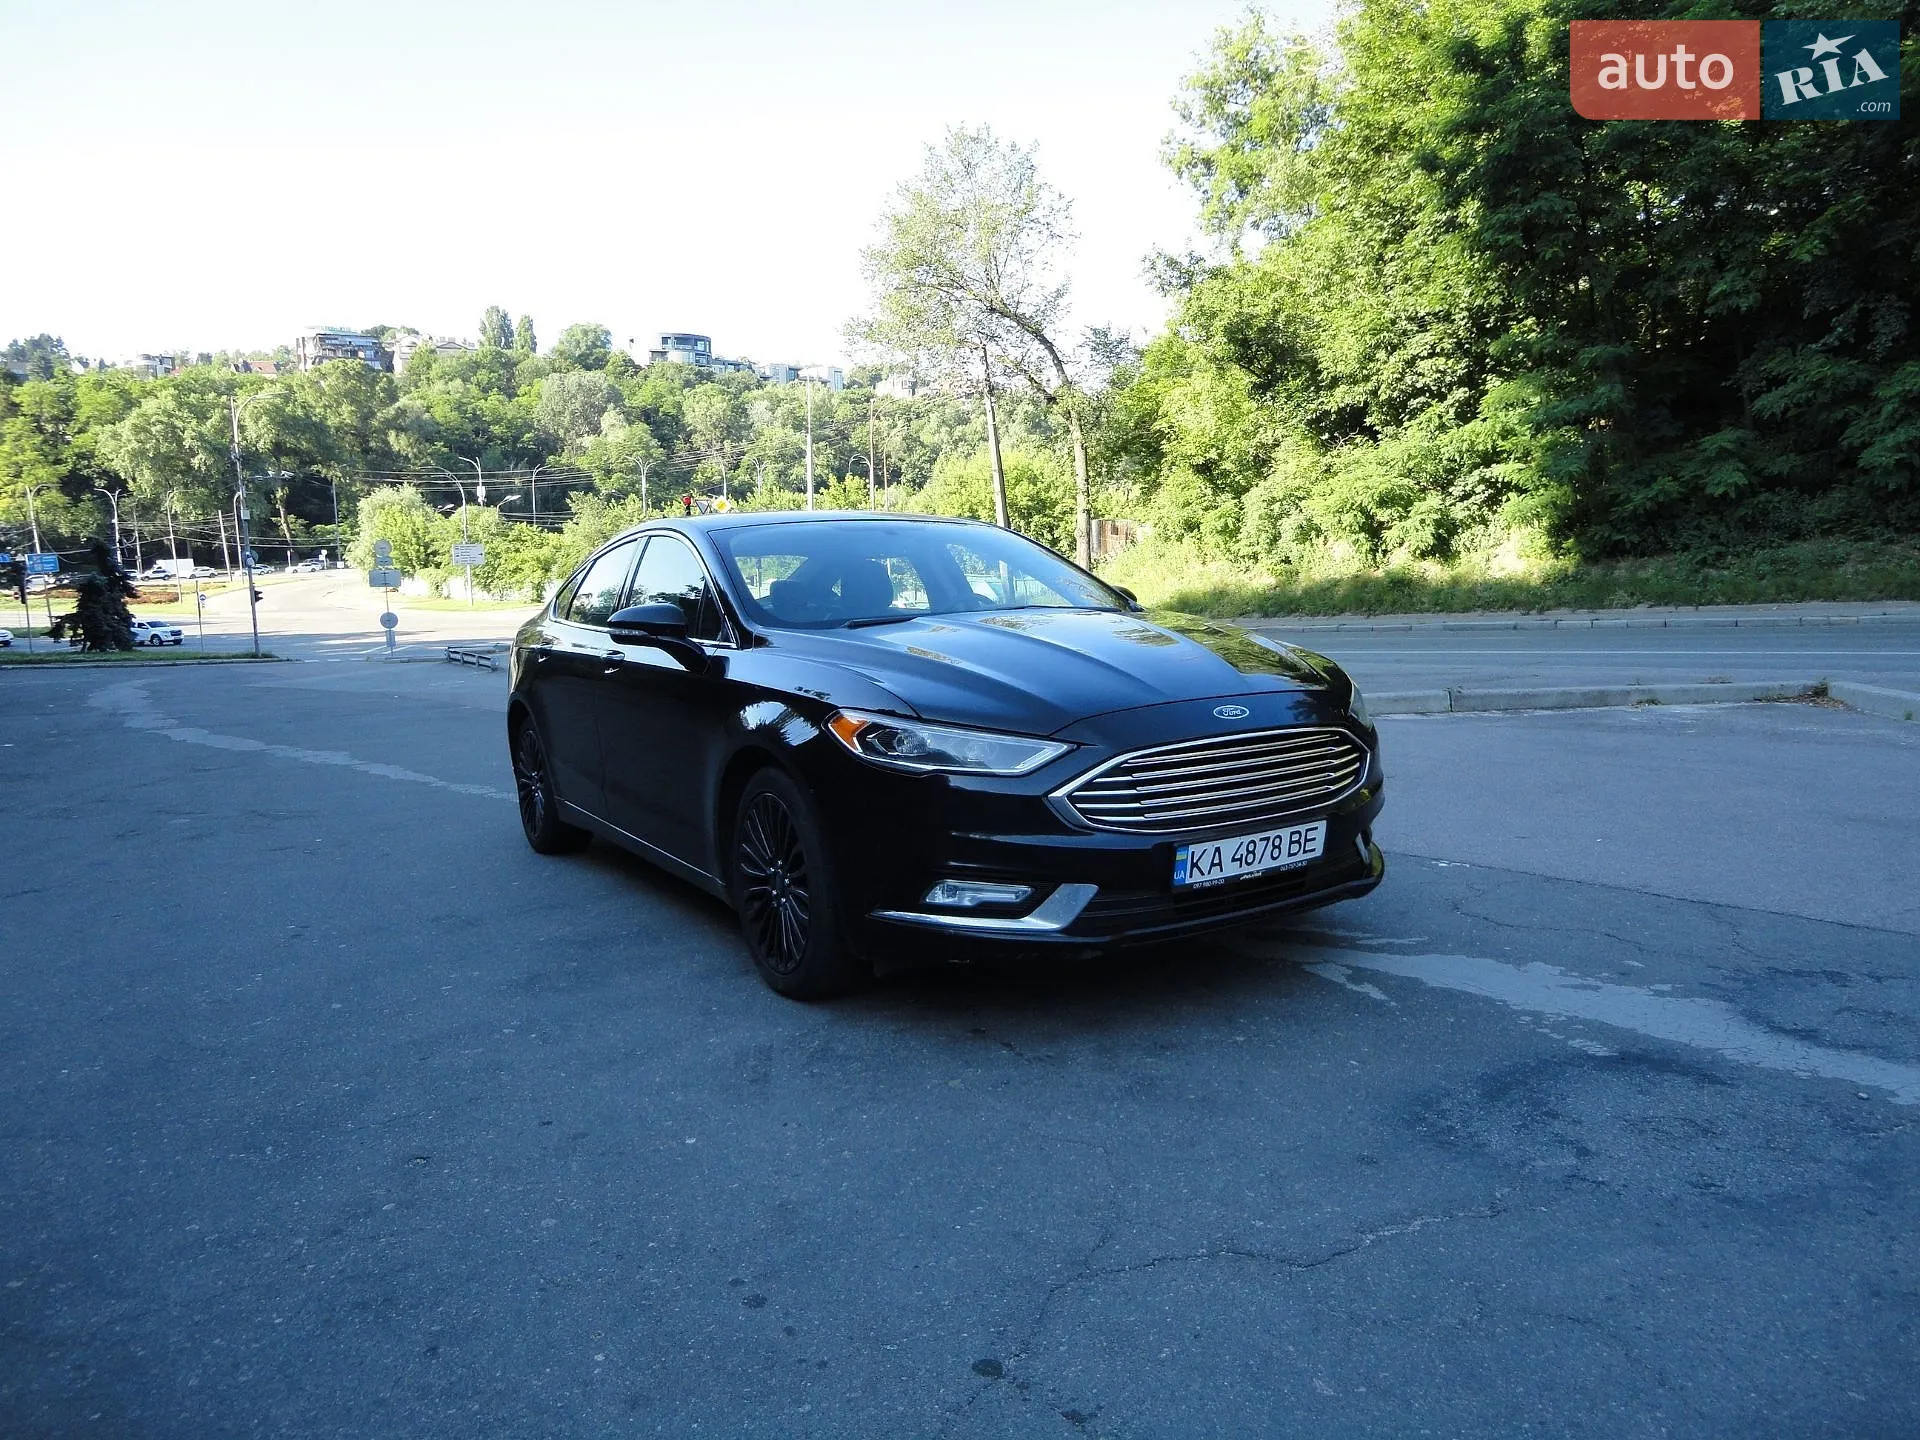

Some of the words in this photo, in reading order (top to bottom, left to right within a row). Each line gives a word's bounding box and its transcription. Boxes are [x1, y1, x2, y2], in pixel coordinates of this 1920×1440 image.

[1188, 846, 1224, 879] KA
[1230, 834, 1283, 869] 4878
[1287, 826, 1319, 858] BE
[1173, 870, 1186, 880] UA
